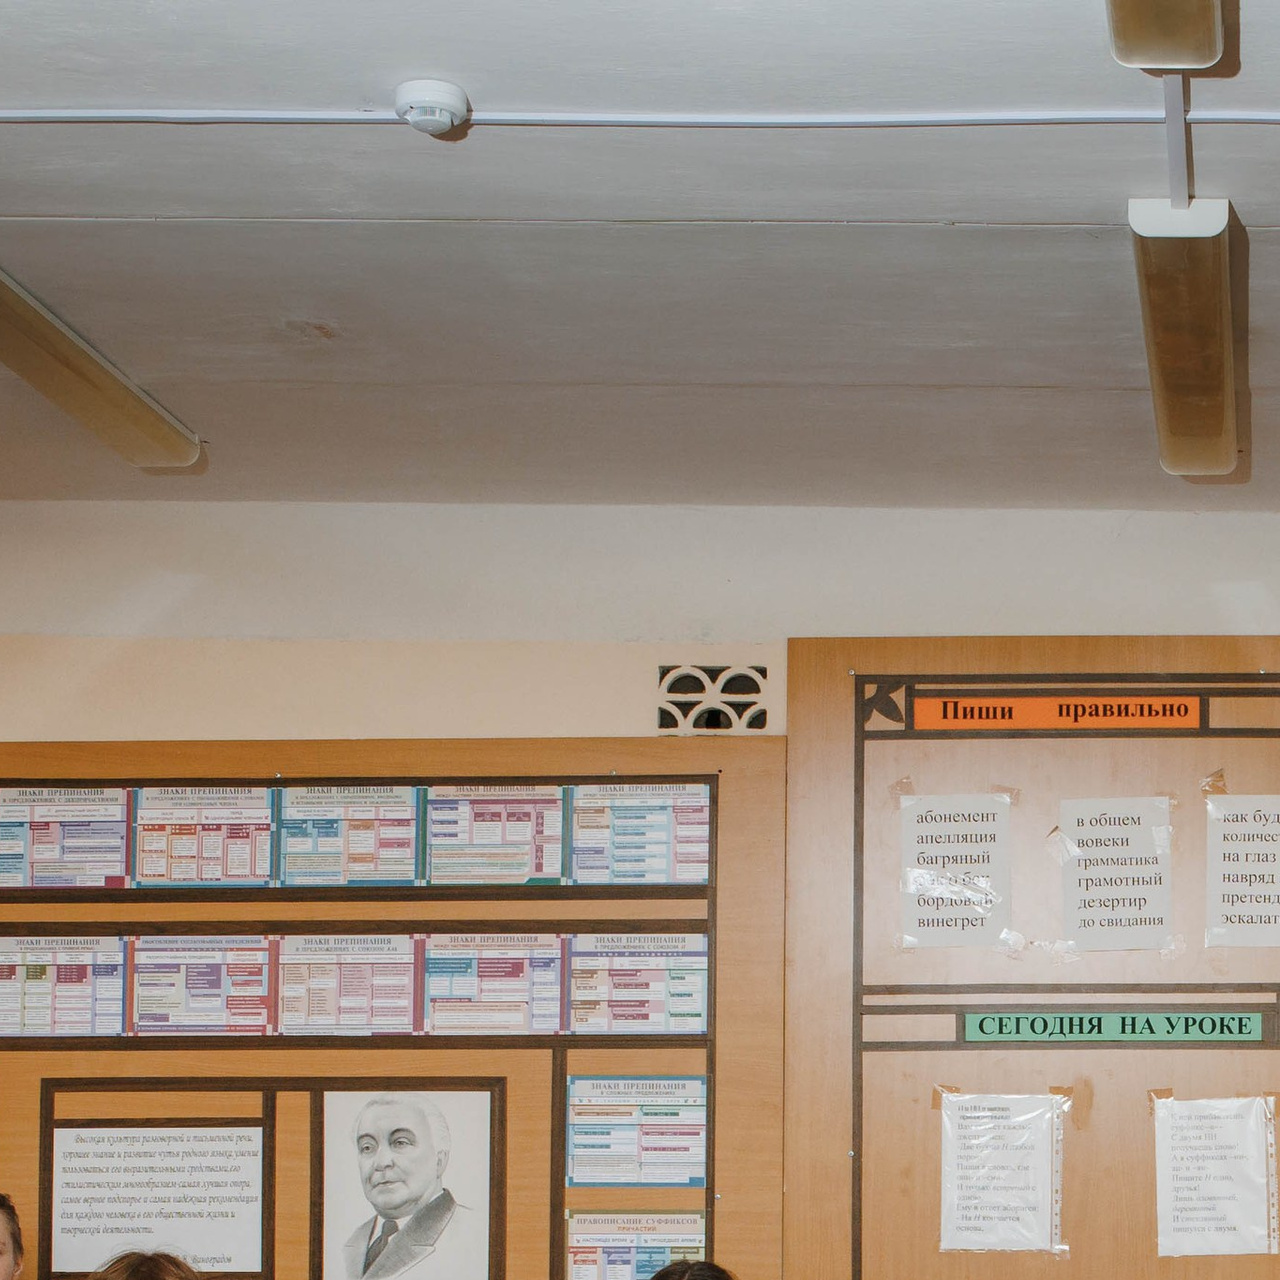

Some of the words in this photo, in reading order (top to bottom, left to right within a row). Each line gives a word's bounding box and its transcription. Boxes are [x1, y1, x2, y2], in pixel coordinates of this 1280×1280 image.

[941, 701, 1013, 720] Пиши
[1058, 700, 1189, 722] правильно
[17, 789, 44, 797] ЗНАКИ
[158, 787, 188, 795] ЗНАКИ
[191, 787, 253, 795] ПРЕПИНАНИЯ
[455, 785, 480, 793] ЗНАКИ
[599, 785, 625, 793] ЗНАКИ
[916, 810, 998, 823] абонемент
[1076, 817, 1085, 827] в
[1089, 813, 1141, 829] общем
[1223, 813, 1248, 824] как
[916, 832, 996, 844] апелляция
[1077, 837, 1129, 848] вовеки
[916, 851, 991, 868] багряный
[1077, 856, 1159, 870] грамматика
[1222, 852, 1240, 863] на
[1245, 852, 1277, 863] глаз
[1078, 872, 1162, 891] грамотный
[1222, 873, 1275, 887] навряд
[1078, 897, 1147, 911] дезертир
[918, 916, 986, 930] винегрет
[1078, 918, 1095, 928] до
[1099, 915, 1164, 928] свидания
[15, 938, 42, 946] ЗНАКИ
[44, 938, 101, 946] ПРЕПИНАНИЯ
[303, 938, 330, 946] ЗНАКИ
[449, 936, 476, 944] ЗНАКИ
[594, 936, 622, 944] ЗНАКИ
[978, 1016, 1102, 1038] СЕГОДНЯ
[1119, 1016, 1157, 1035] НА
[1165, 1015, 1252, 1035] УРОКЕ
[591, 1082, 621, 1090] ЗНАКИ
[623, 1082, 687, 1090] ПРЕПИНАНИЯ
[646, 1217, 698, 1225] СУФФИКСОВ
